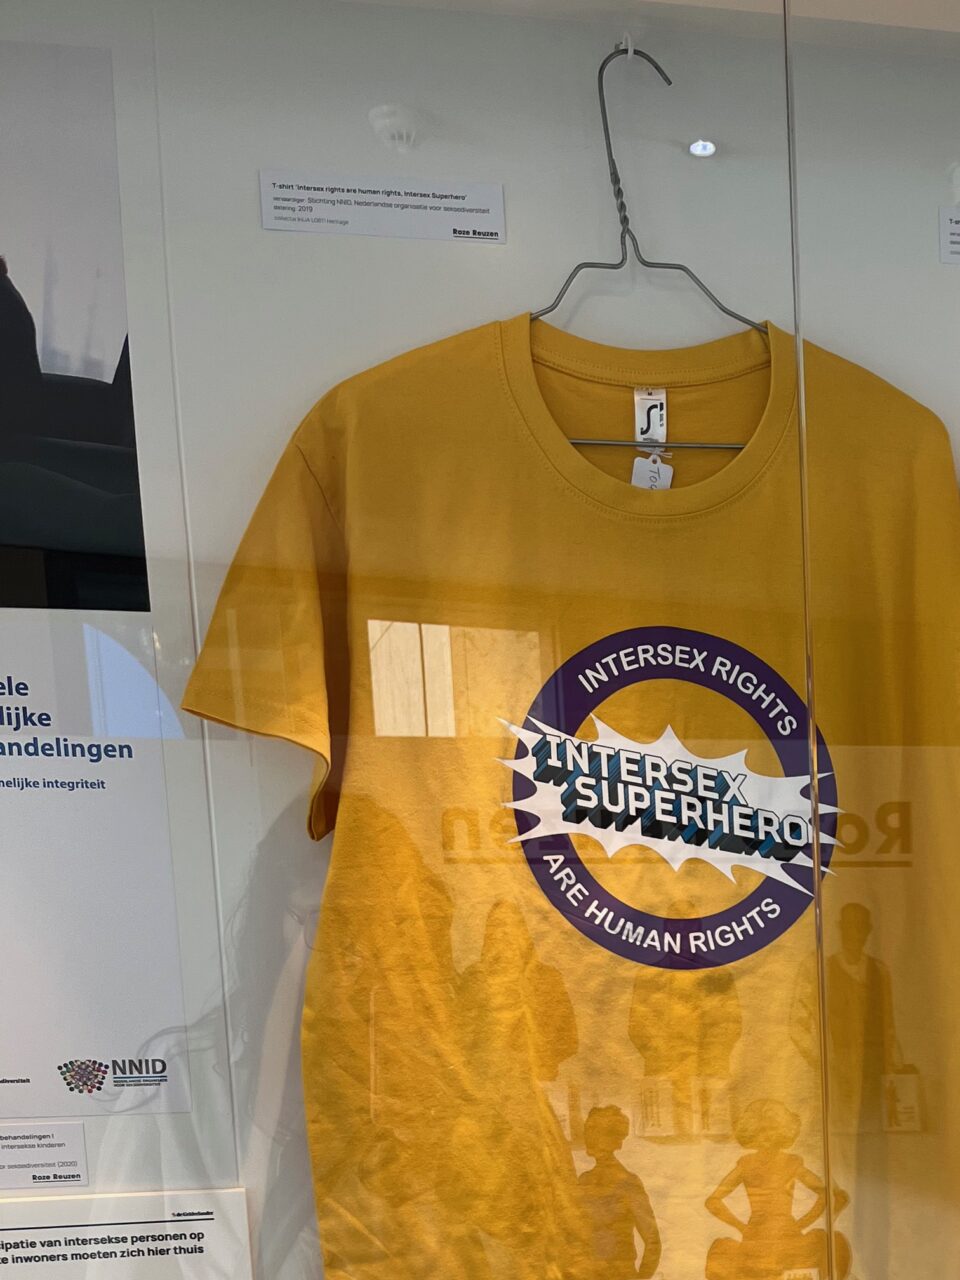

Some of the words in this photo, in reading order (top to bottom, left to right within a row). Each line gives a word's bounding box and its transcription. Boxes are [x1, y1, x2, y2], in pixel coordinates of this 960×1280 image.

[452, 228, 471, 236] Roze
[472, 229, 499, 237] Reuzen
[578, 644, 706, 694] INTERSEX
[712, 656, 798, 736] RIGHTS
[540, 734, 748, 806] INTERSEX
[43, 778, 107, 791] integriteit
[566, 776, 809, 850] SUPERHERO
[543, 853, 589, 907] ARE
[585, 899, 681, 954] HUMAN
[688, 897, 782, 954] RIGHTS
[111, 1058, 167, 1076] NNID
[52, 1173, 81, 1181] Reuzen
[0, 1239, 38, 1253] ipatie
[39, 1239, 62, 1248] van
[64, 1235, 129, 1247] intersekse
[130, 1232, 188, 1246] personen
[189, 1232, 205, 1242] op
[11, 1253, 69, 1264] inwoners
[70, 1250, 118, 1261] moeten
[119, 1247, 146, 1258] zich
[147, 1246, 172, 1257] hier
[172, 1244, 205, 1255] thuis
